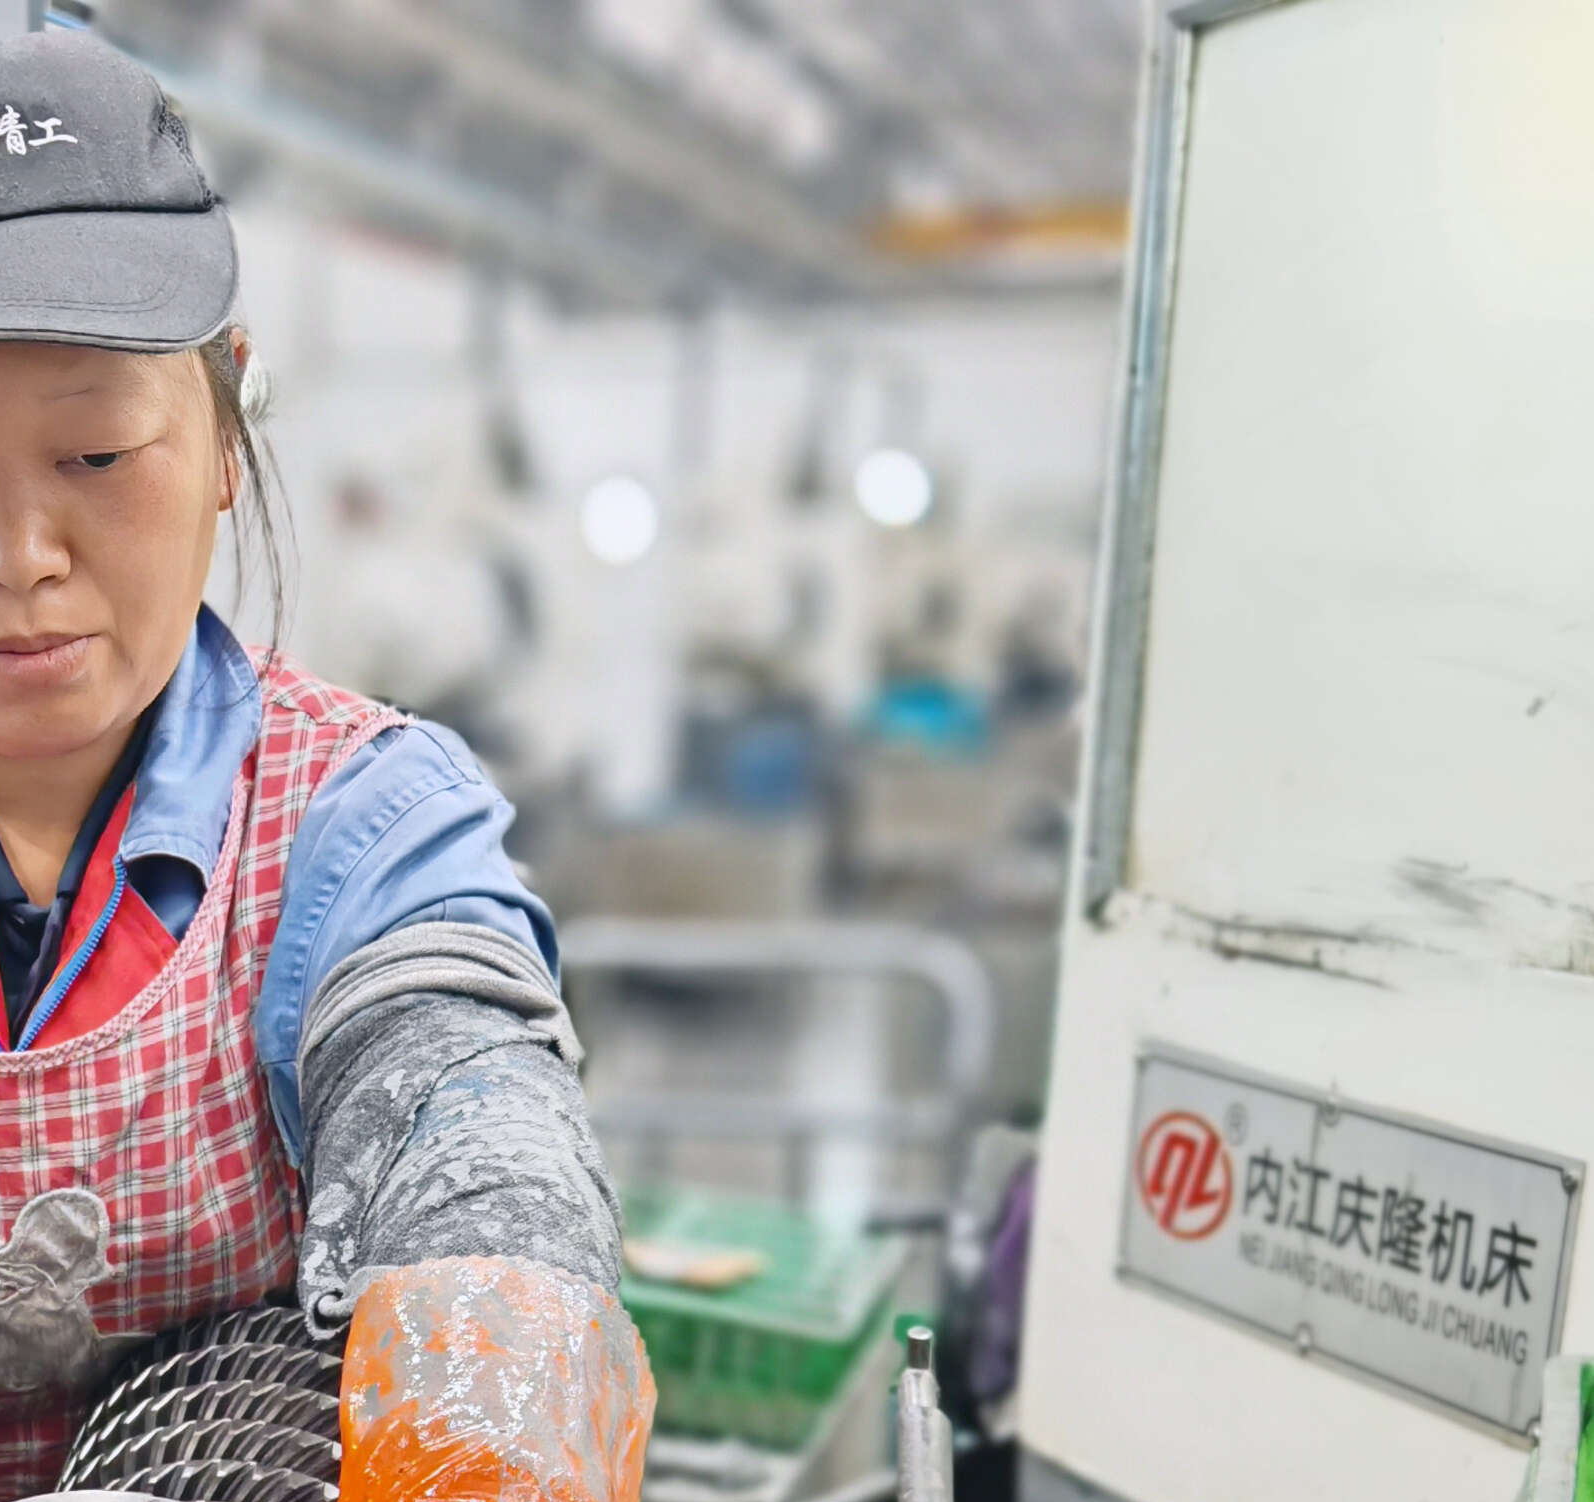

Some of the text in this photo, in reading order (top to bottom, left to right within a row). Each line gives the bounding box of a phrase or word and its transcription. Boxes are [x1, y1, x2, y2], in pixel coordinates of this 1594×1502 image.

[1242, 1146, 1538, 1308] 内江庆隆机床
[1267, 1243, 1316, 1288] JIANG
[1320, 1259, 1364, 1305] QING
[1366, 1277, 1419, 1326] LONG
[1422, 1298, 1439, 1332] JI
[1441, 1304, 1529, 1367] CHUANG
